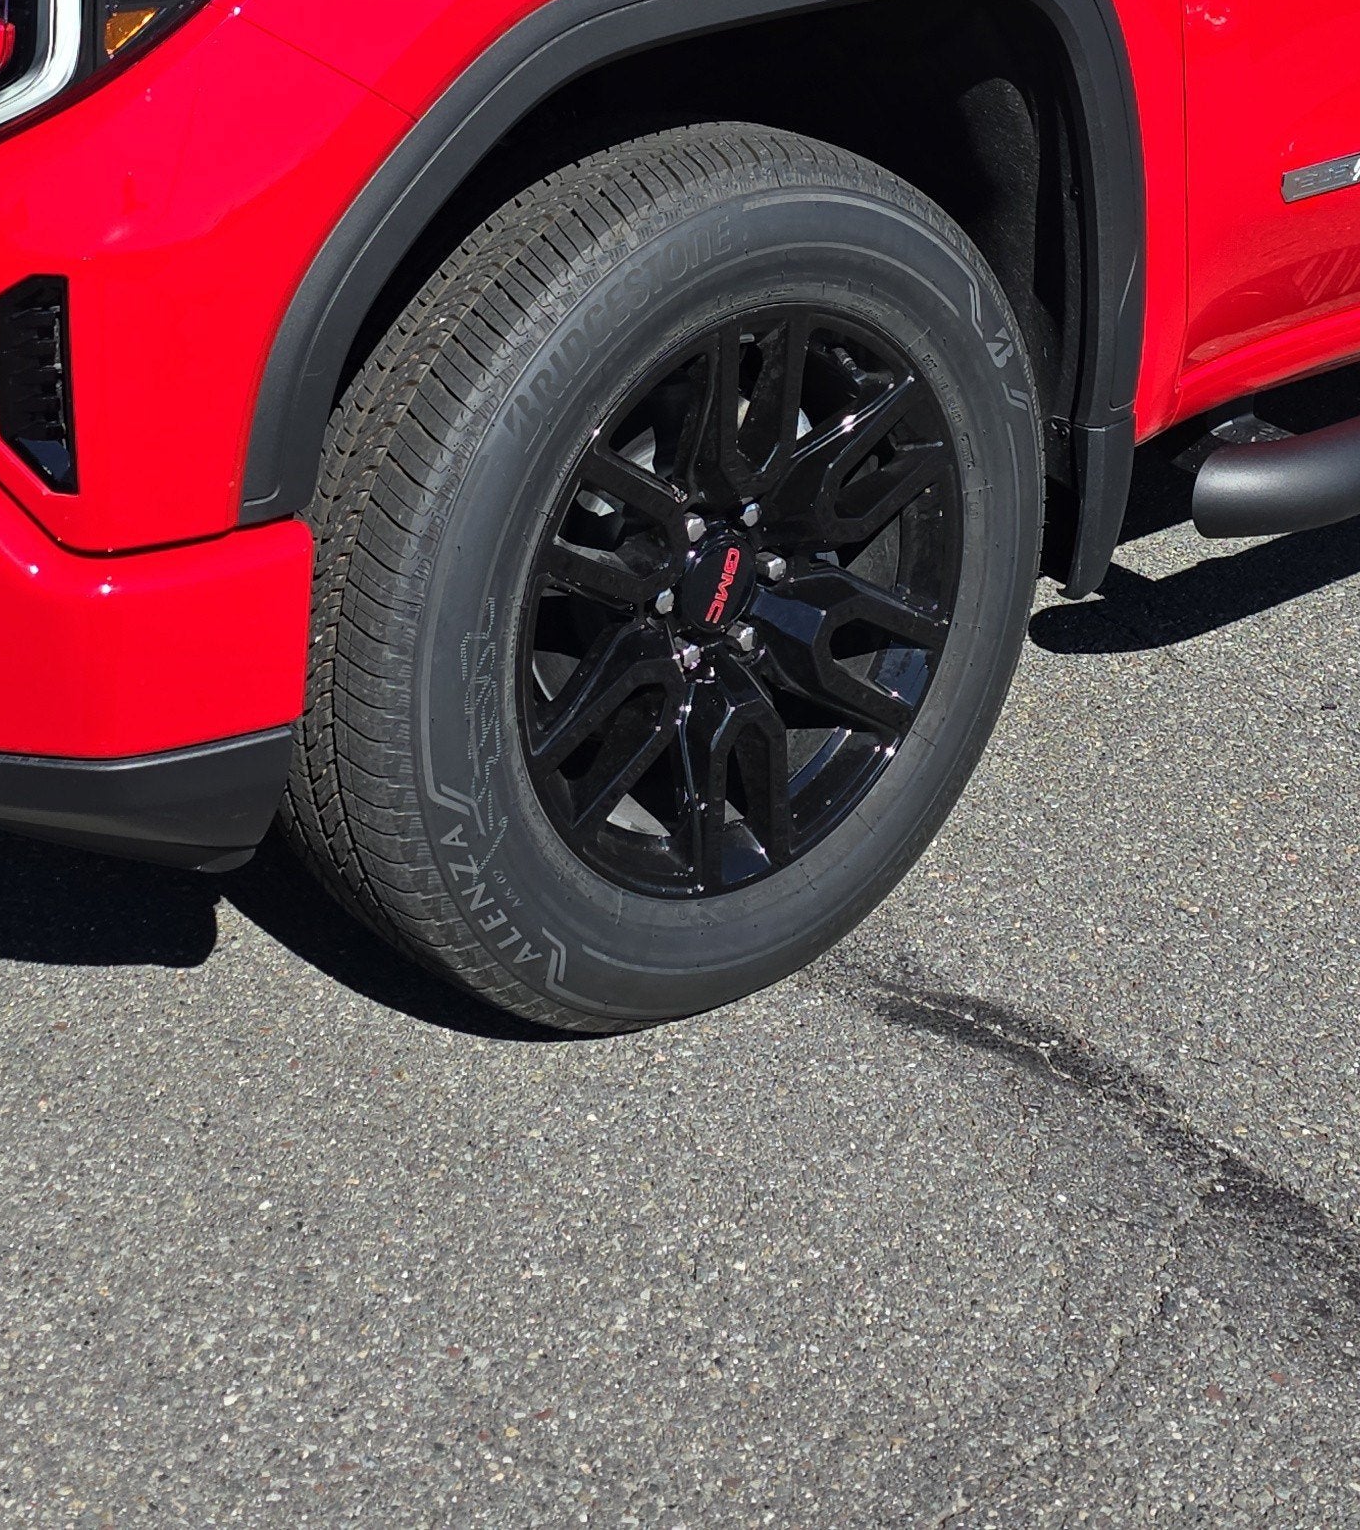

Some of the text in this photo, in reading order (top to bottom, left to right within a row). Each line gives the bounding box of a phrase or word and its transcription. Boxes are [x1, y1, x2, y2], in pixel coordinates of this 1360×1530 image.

[501, 216, 733, 453] BRIDGESTONE
[704, 547, 741, 624] GMC
[440, 823, 543, 964] ALENZA
